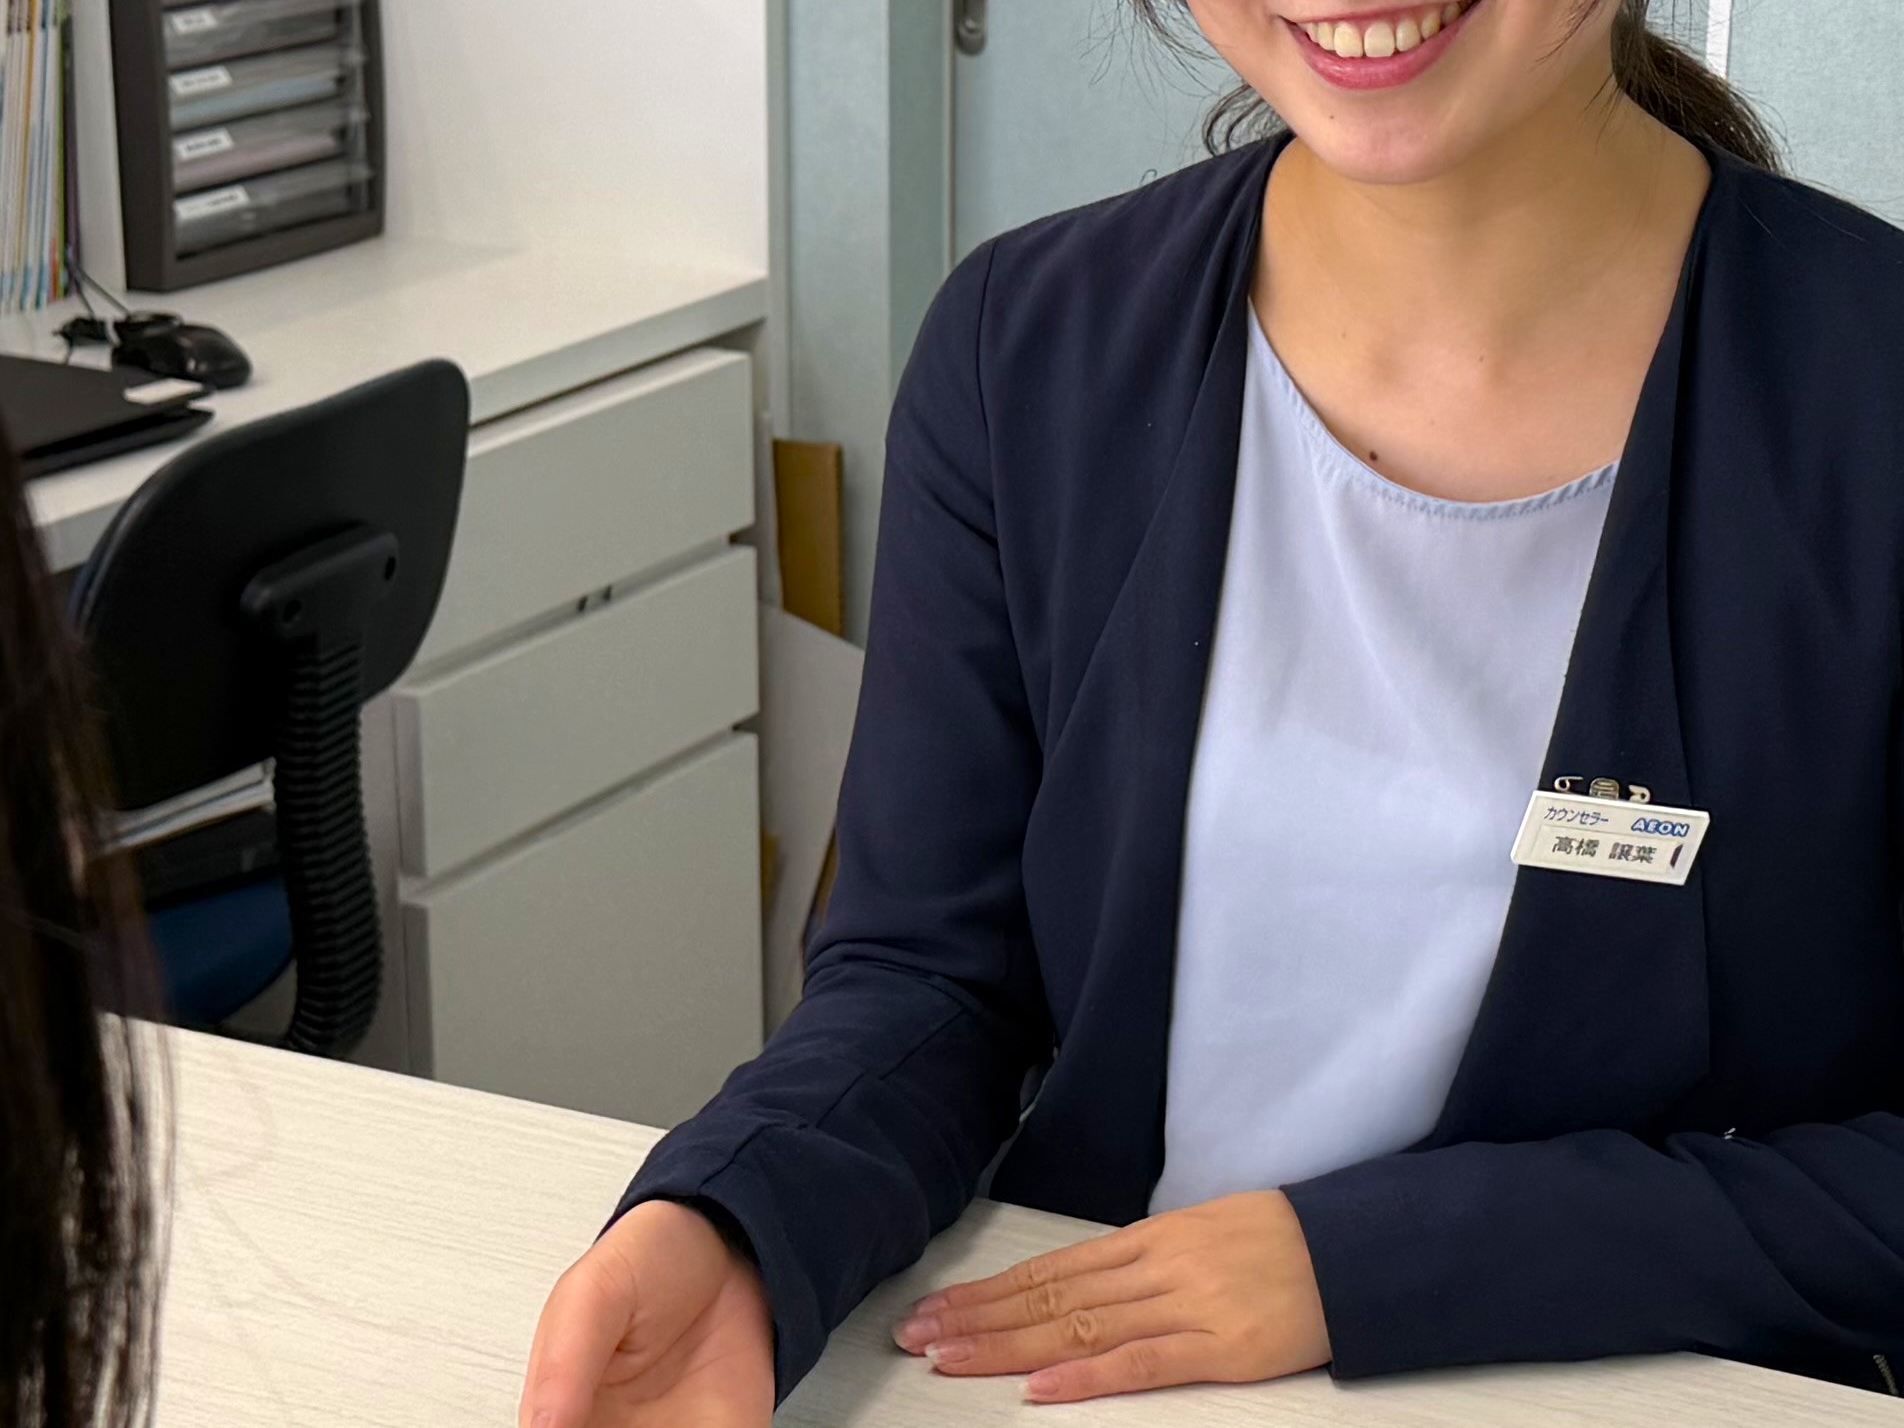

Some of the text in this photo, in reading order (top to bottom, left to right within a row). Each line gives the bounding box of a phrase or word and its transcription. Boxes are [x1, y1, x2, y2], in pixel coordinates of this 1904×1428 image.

[1544, 805, 1610, 826] カウンセラー
[1631, 817, 1690, 837] AEON
